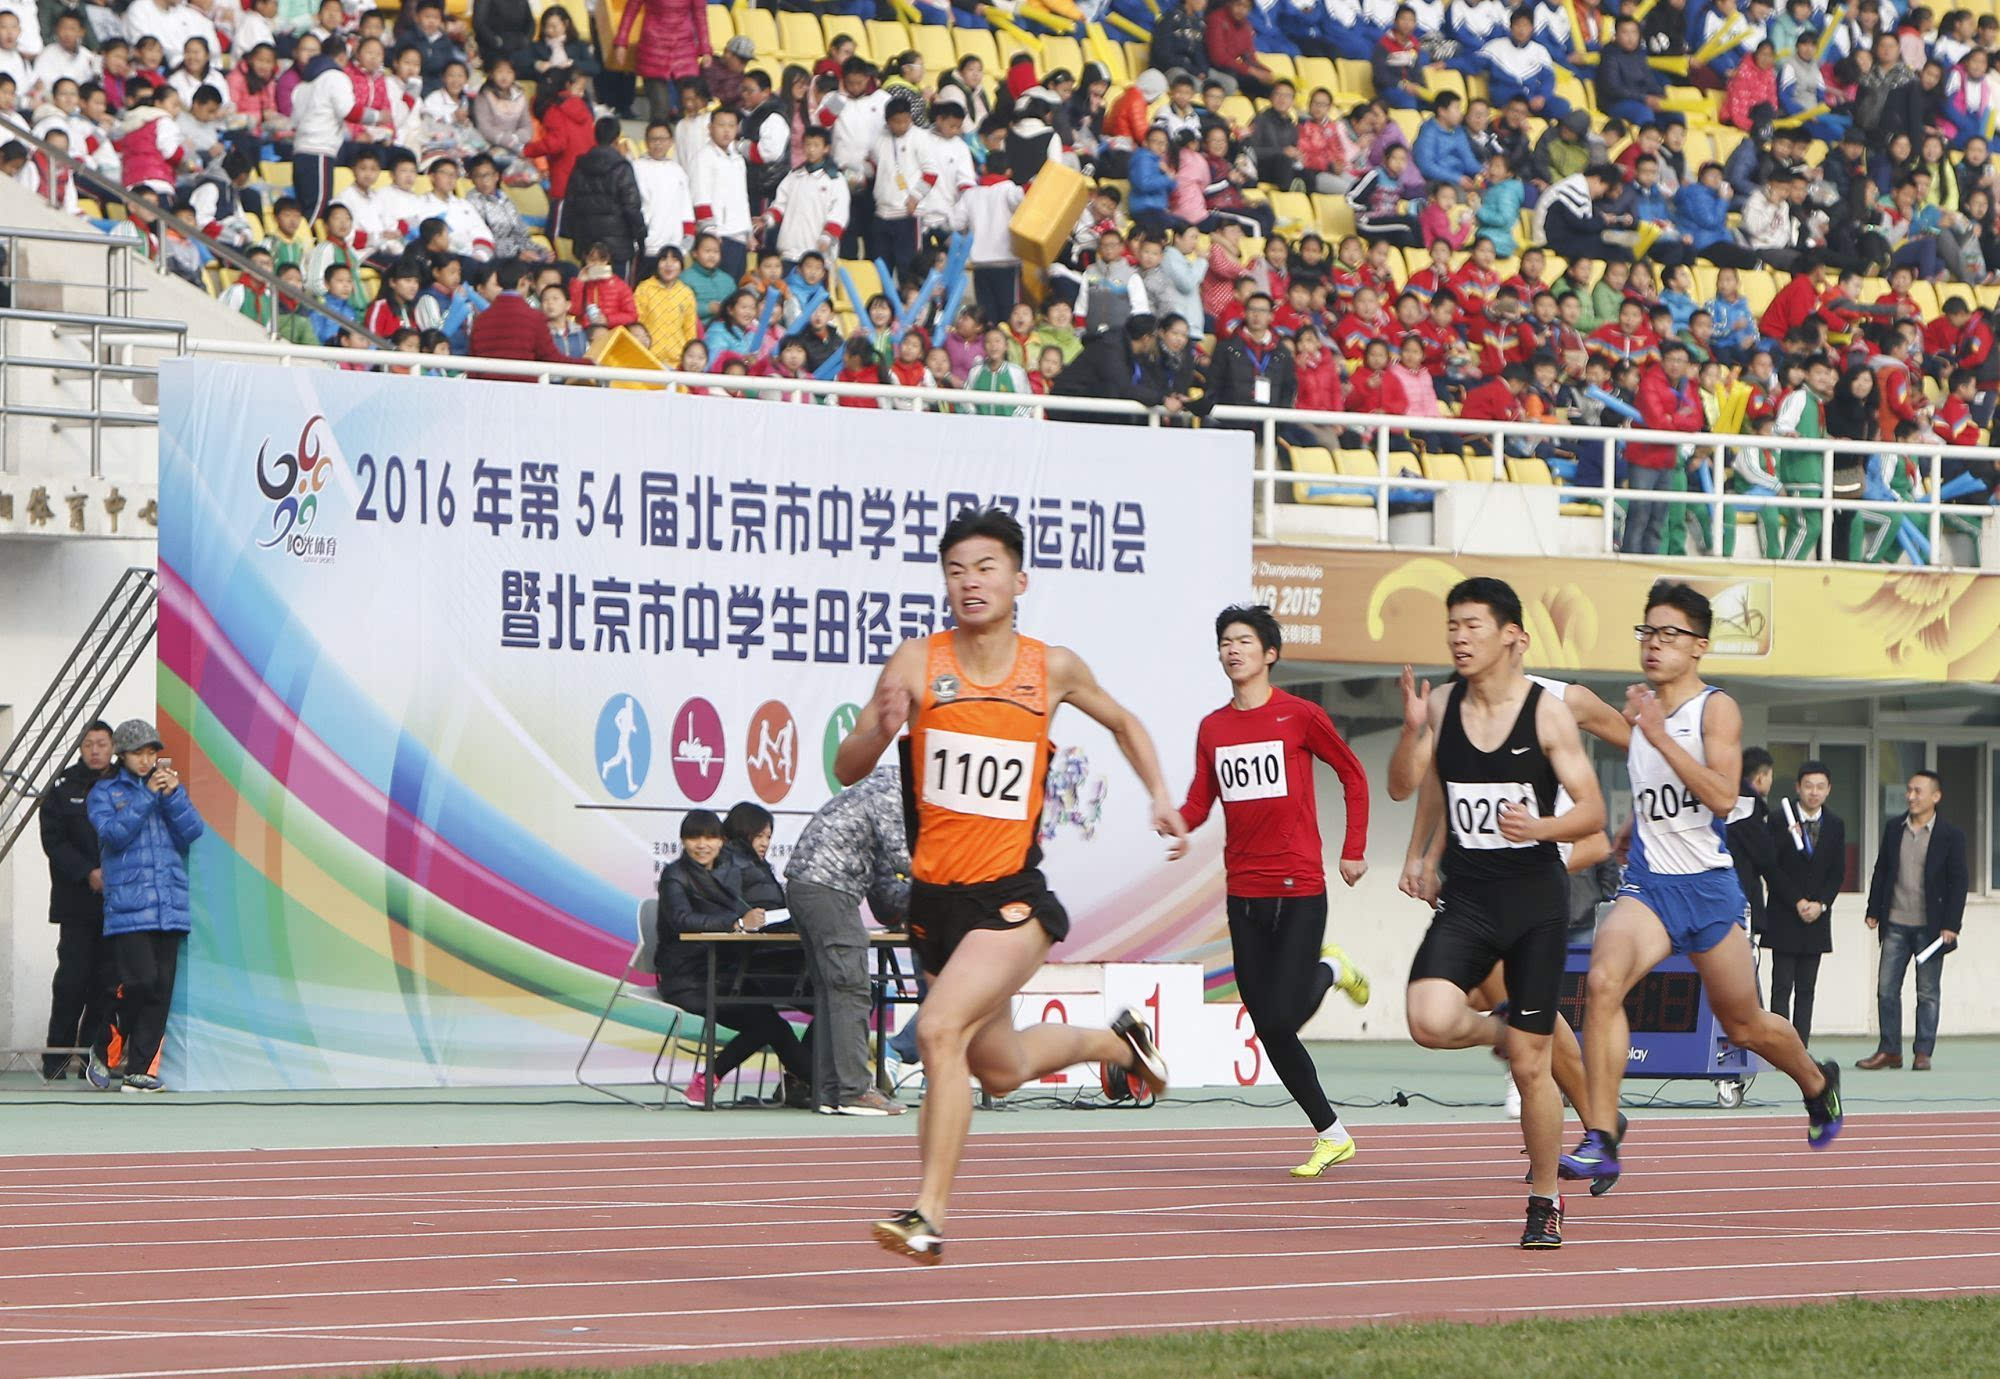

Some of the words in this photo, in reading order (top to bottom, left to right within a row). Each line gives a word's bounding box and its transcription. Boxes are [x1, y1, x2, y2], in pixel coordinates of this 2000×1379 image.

[356, 453, 456, 528] 2016
[473, 458, 560, 540] 年第
[576, 471, 624, 537] 54
[639, 471, 1146, 573] 届北京市中学生运动会
[287, 533, 337, 557] 阳光体育
[1259, 561, 1323, 581] Championships
[500, 568, 1018, 665] 暨北京市中学生田径冠
[1280, 585, 1323, 616] 2015
[934, 749, 1023, 801] 1102
[1221, 754, 1279, 788] 0610
[1145, 983, 1160, 1051] 1
[1234, 1003, 1262, 1086] 3
